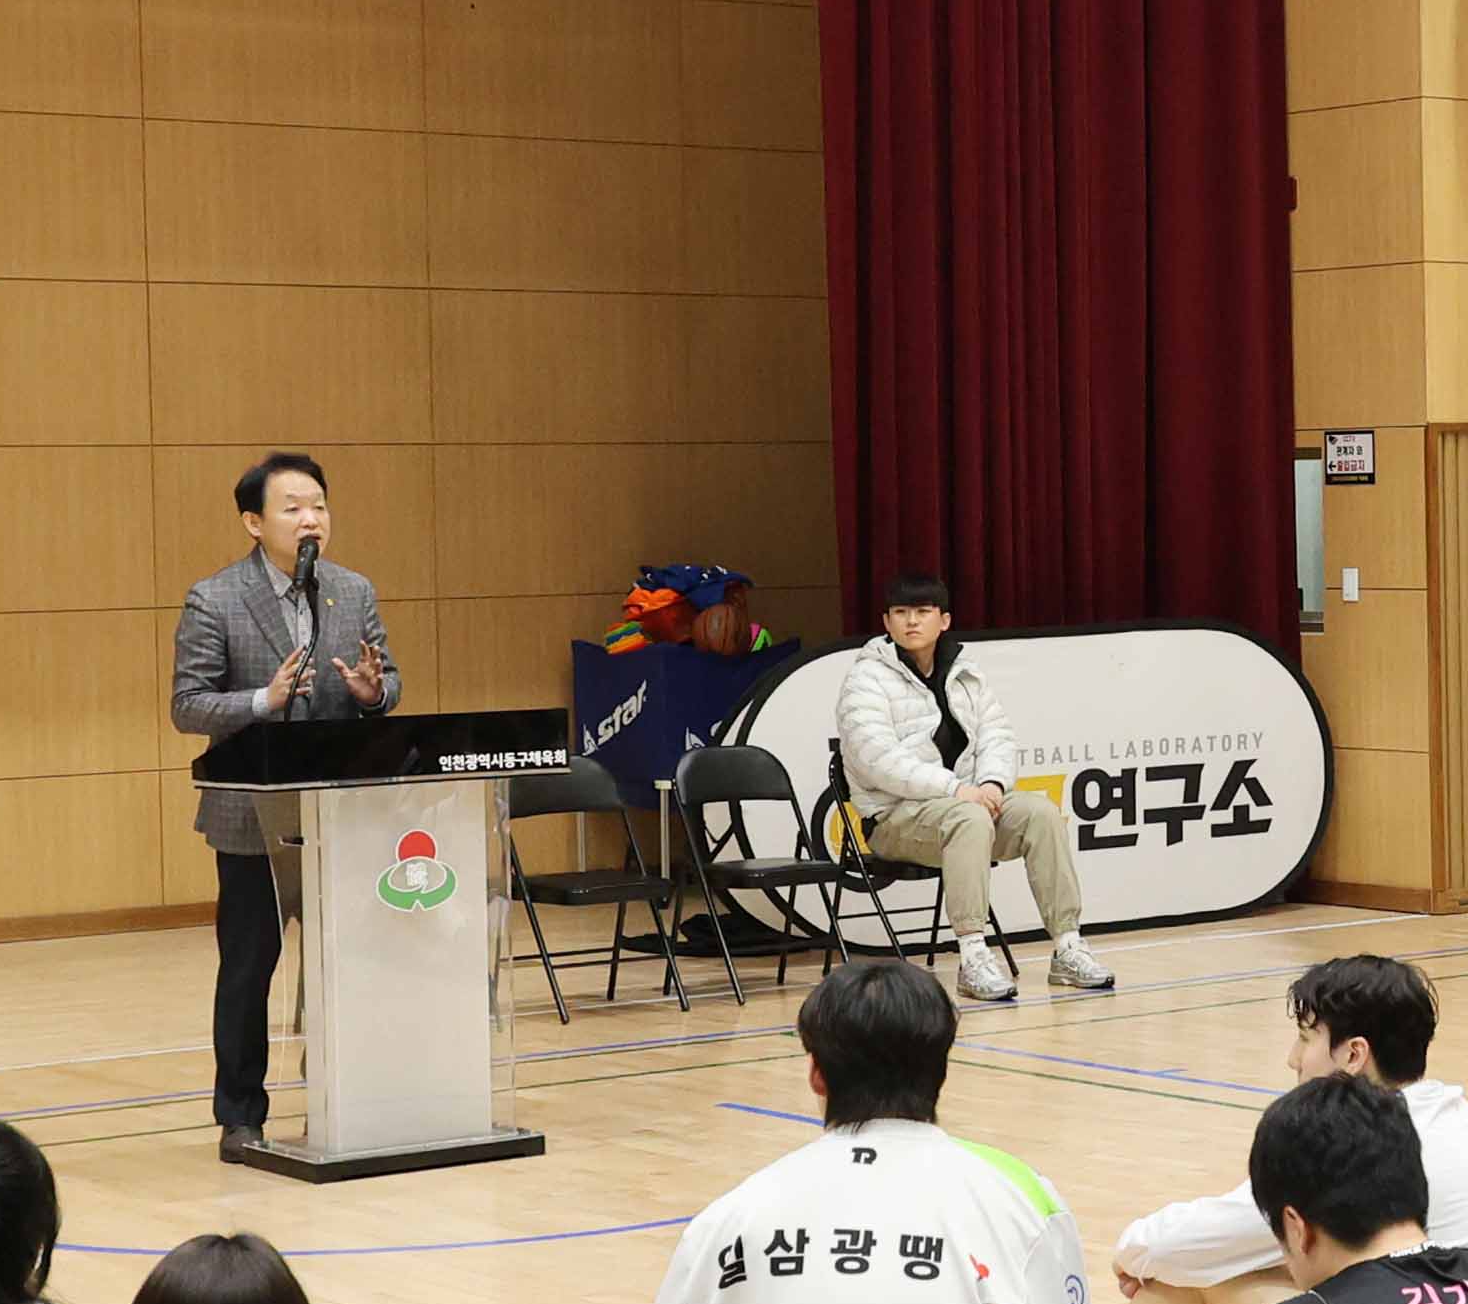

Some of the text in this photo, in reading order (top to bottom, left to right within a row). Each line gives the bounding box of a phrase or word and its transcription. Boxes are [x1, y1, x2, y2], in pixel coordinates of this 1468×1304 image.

[438, 748, 568, 772] 인천광역시동구체육회
[1016, 731, 1265, 767] TBALL LABORATORY
